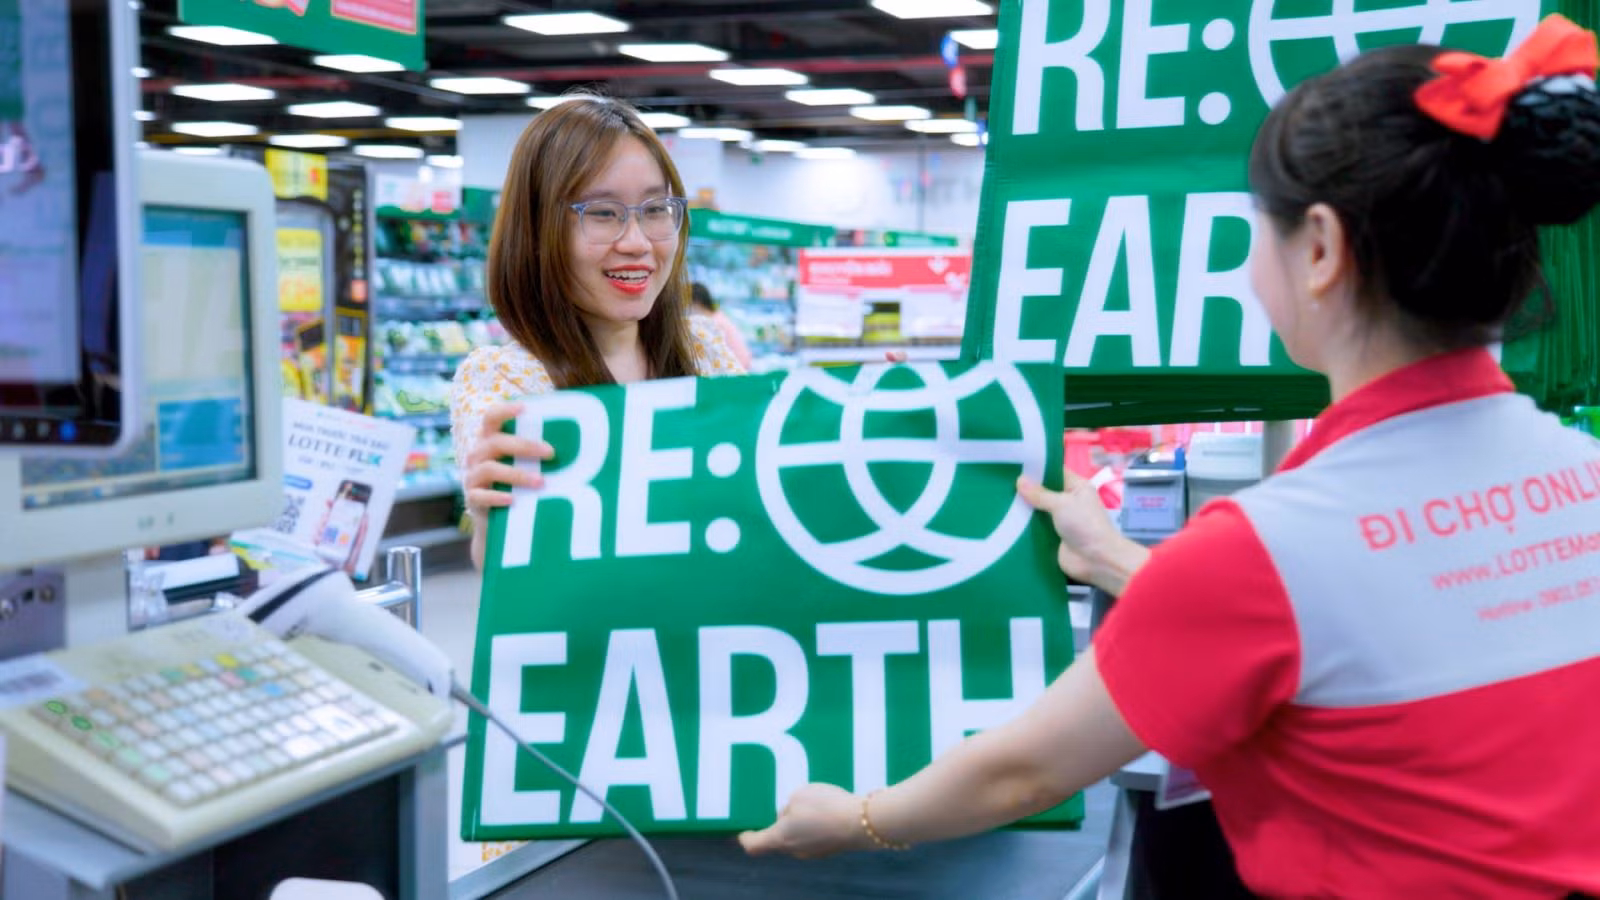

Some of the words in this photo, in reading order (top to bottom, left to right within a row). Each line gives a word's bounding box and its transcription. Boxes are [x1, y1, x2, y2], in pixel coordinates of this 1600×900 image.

[1012, 0, 1235, 136] RE:
[992, 192, 1272, 368] EAR
[287, 433, 344, 458] LOTTE
[502, 378, 742, 568] RE:
[1358, 508, 1416, 551] ĐI
[1422, 484, 1516, 537] CHỢ
[480, 617, 1046, 827] EARTH
